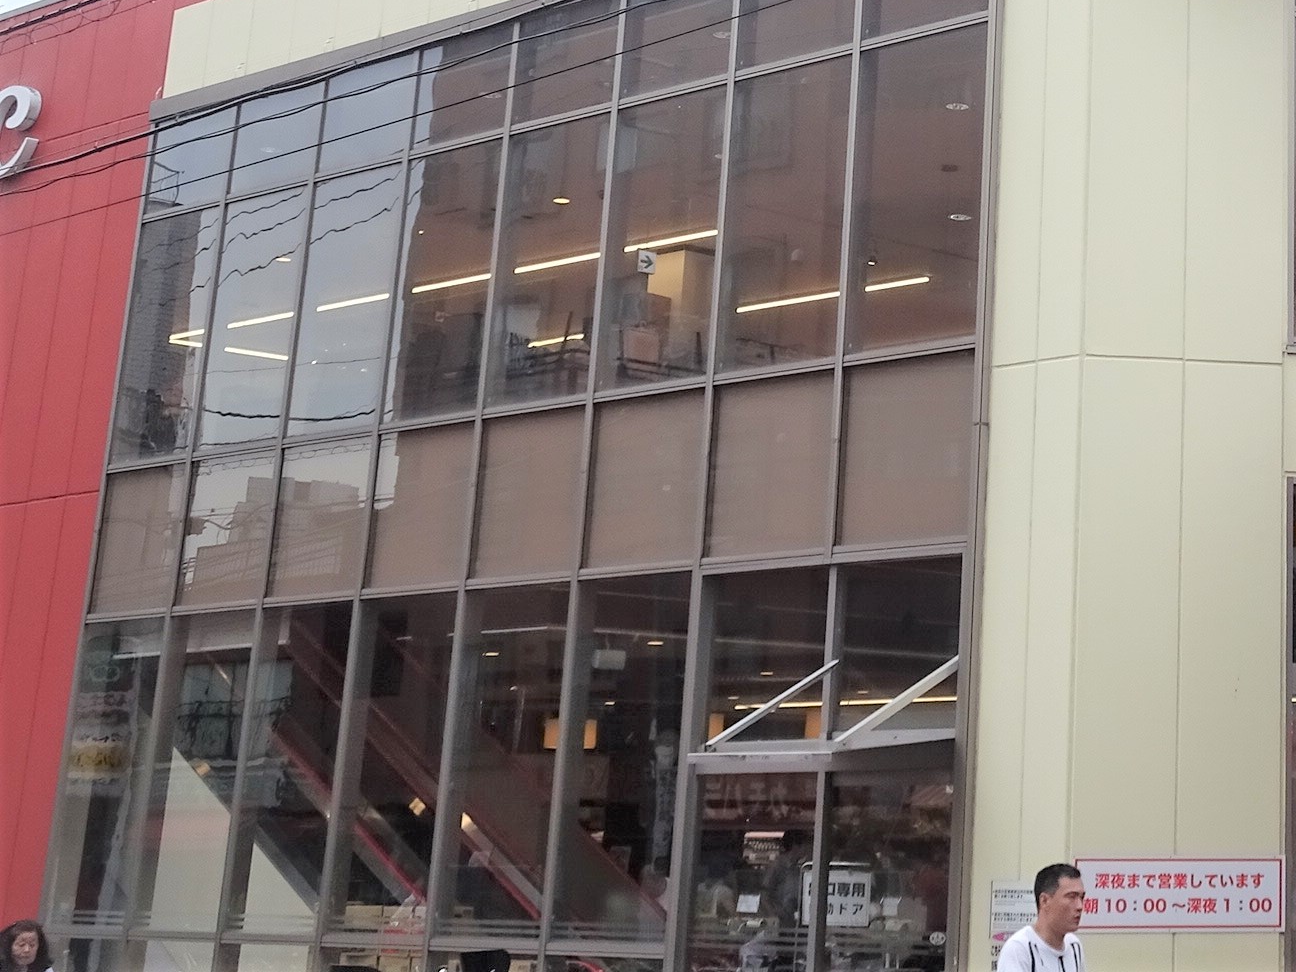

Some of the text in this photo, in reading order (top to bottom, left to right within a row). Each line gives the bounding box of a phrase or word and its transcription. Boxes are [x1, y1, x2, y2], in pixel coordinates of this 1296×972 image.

[1095, 872, 1264, 890] 深夜まで営業しています
[808, 882, 866, 898] 口専用
[828, 902, 864, 916] ドア
